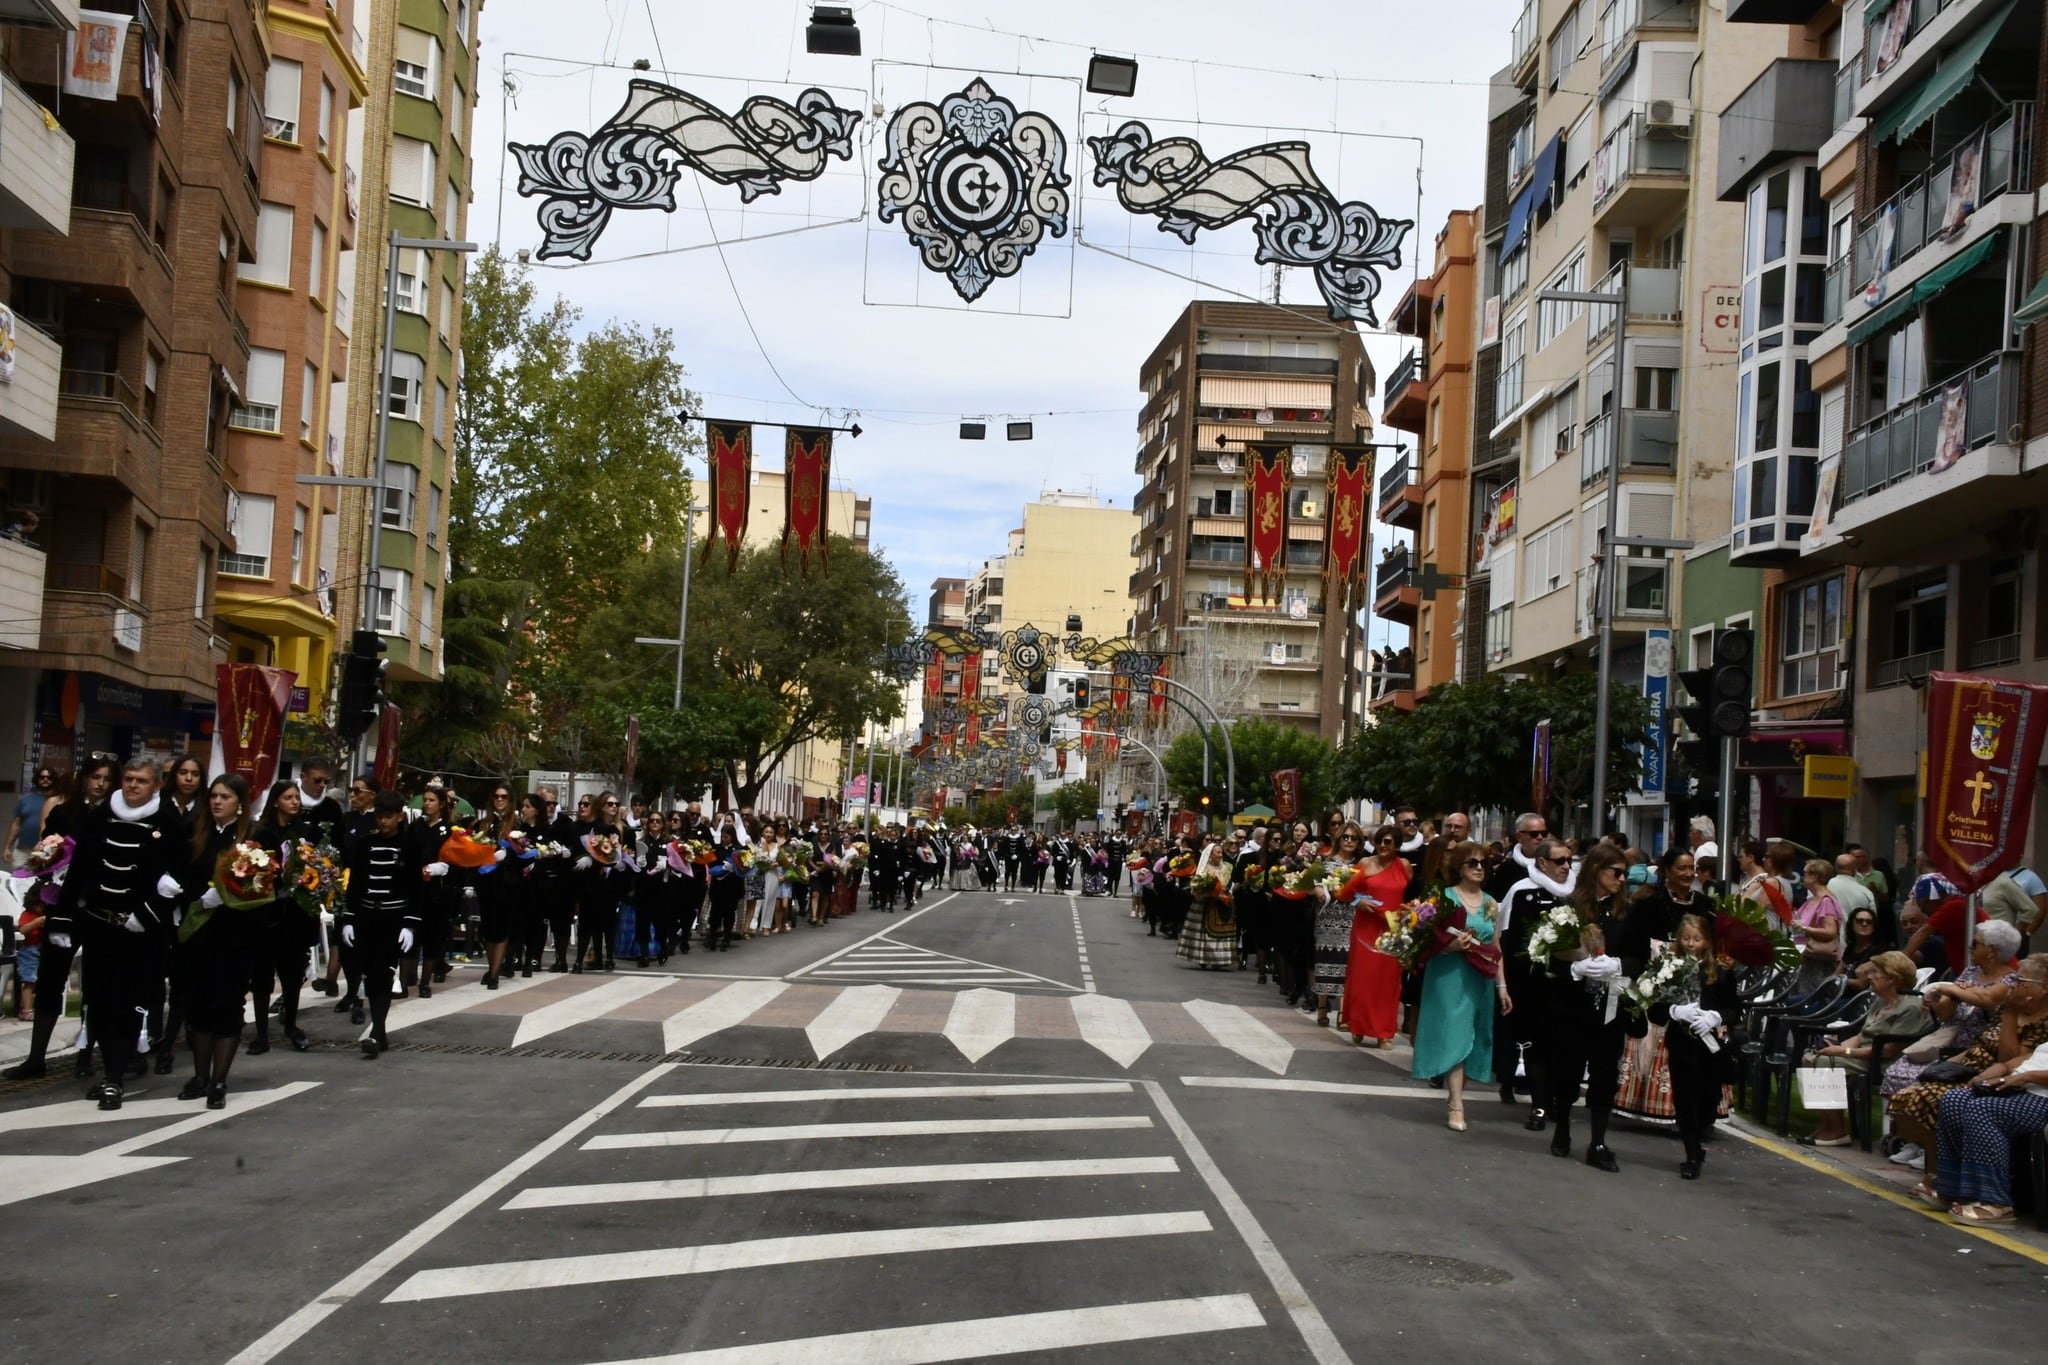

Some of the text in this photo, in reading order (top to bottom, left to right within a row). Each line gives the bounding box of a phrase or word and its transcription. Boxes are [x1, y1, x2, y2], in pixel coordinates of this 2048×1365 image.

[1650, 691, 1662, 730] FBRA
[1648, 731, 1660, 786] AVANA
[1950, 828, 1994, 842] VILLENA
